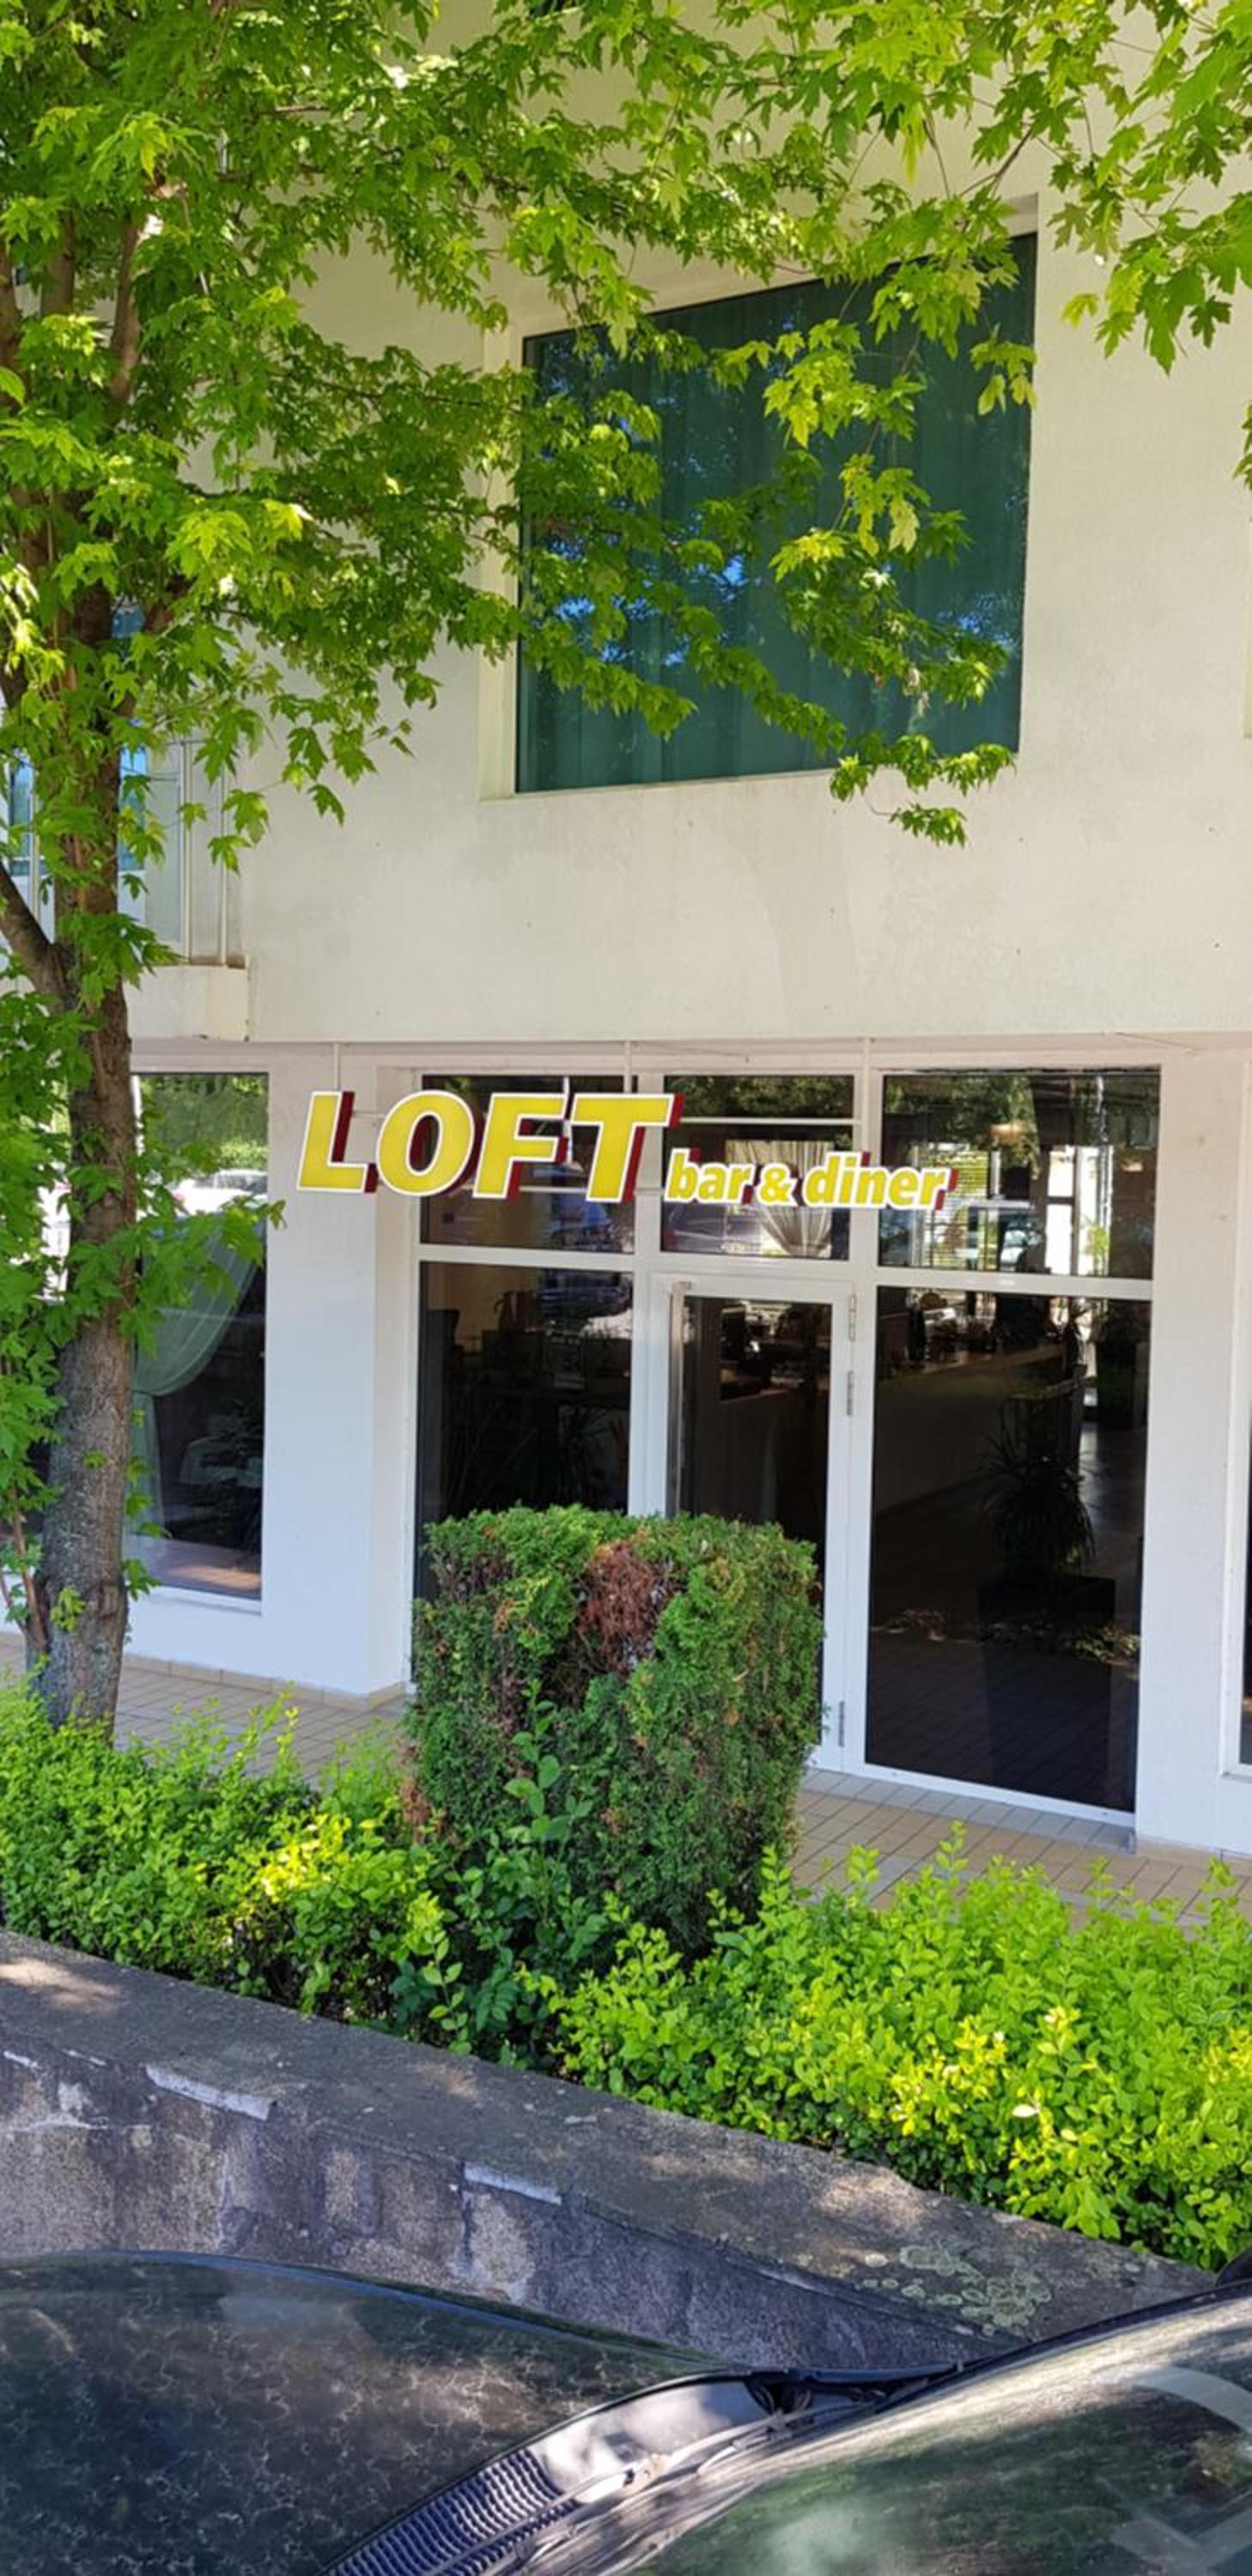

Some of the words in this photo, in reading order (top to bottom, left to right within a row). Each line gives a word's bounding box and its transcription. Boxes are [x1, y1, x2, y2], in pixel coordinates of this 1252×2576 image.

[296, 1090, 676, 1203] LOFT
[664, 1148, 755, 1204] bar
[757, 1162, 798, 1206] &
[802, 1151, 951, 1209] diner
